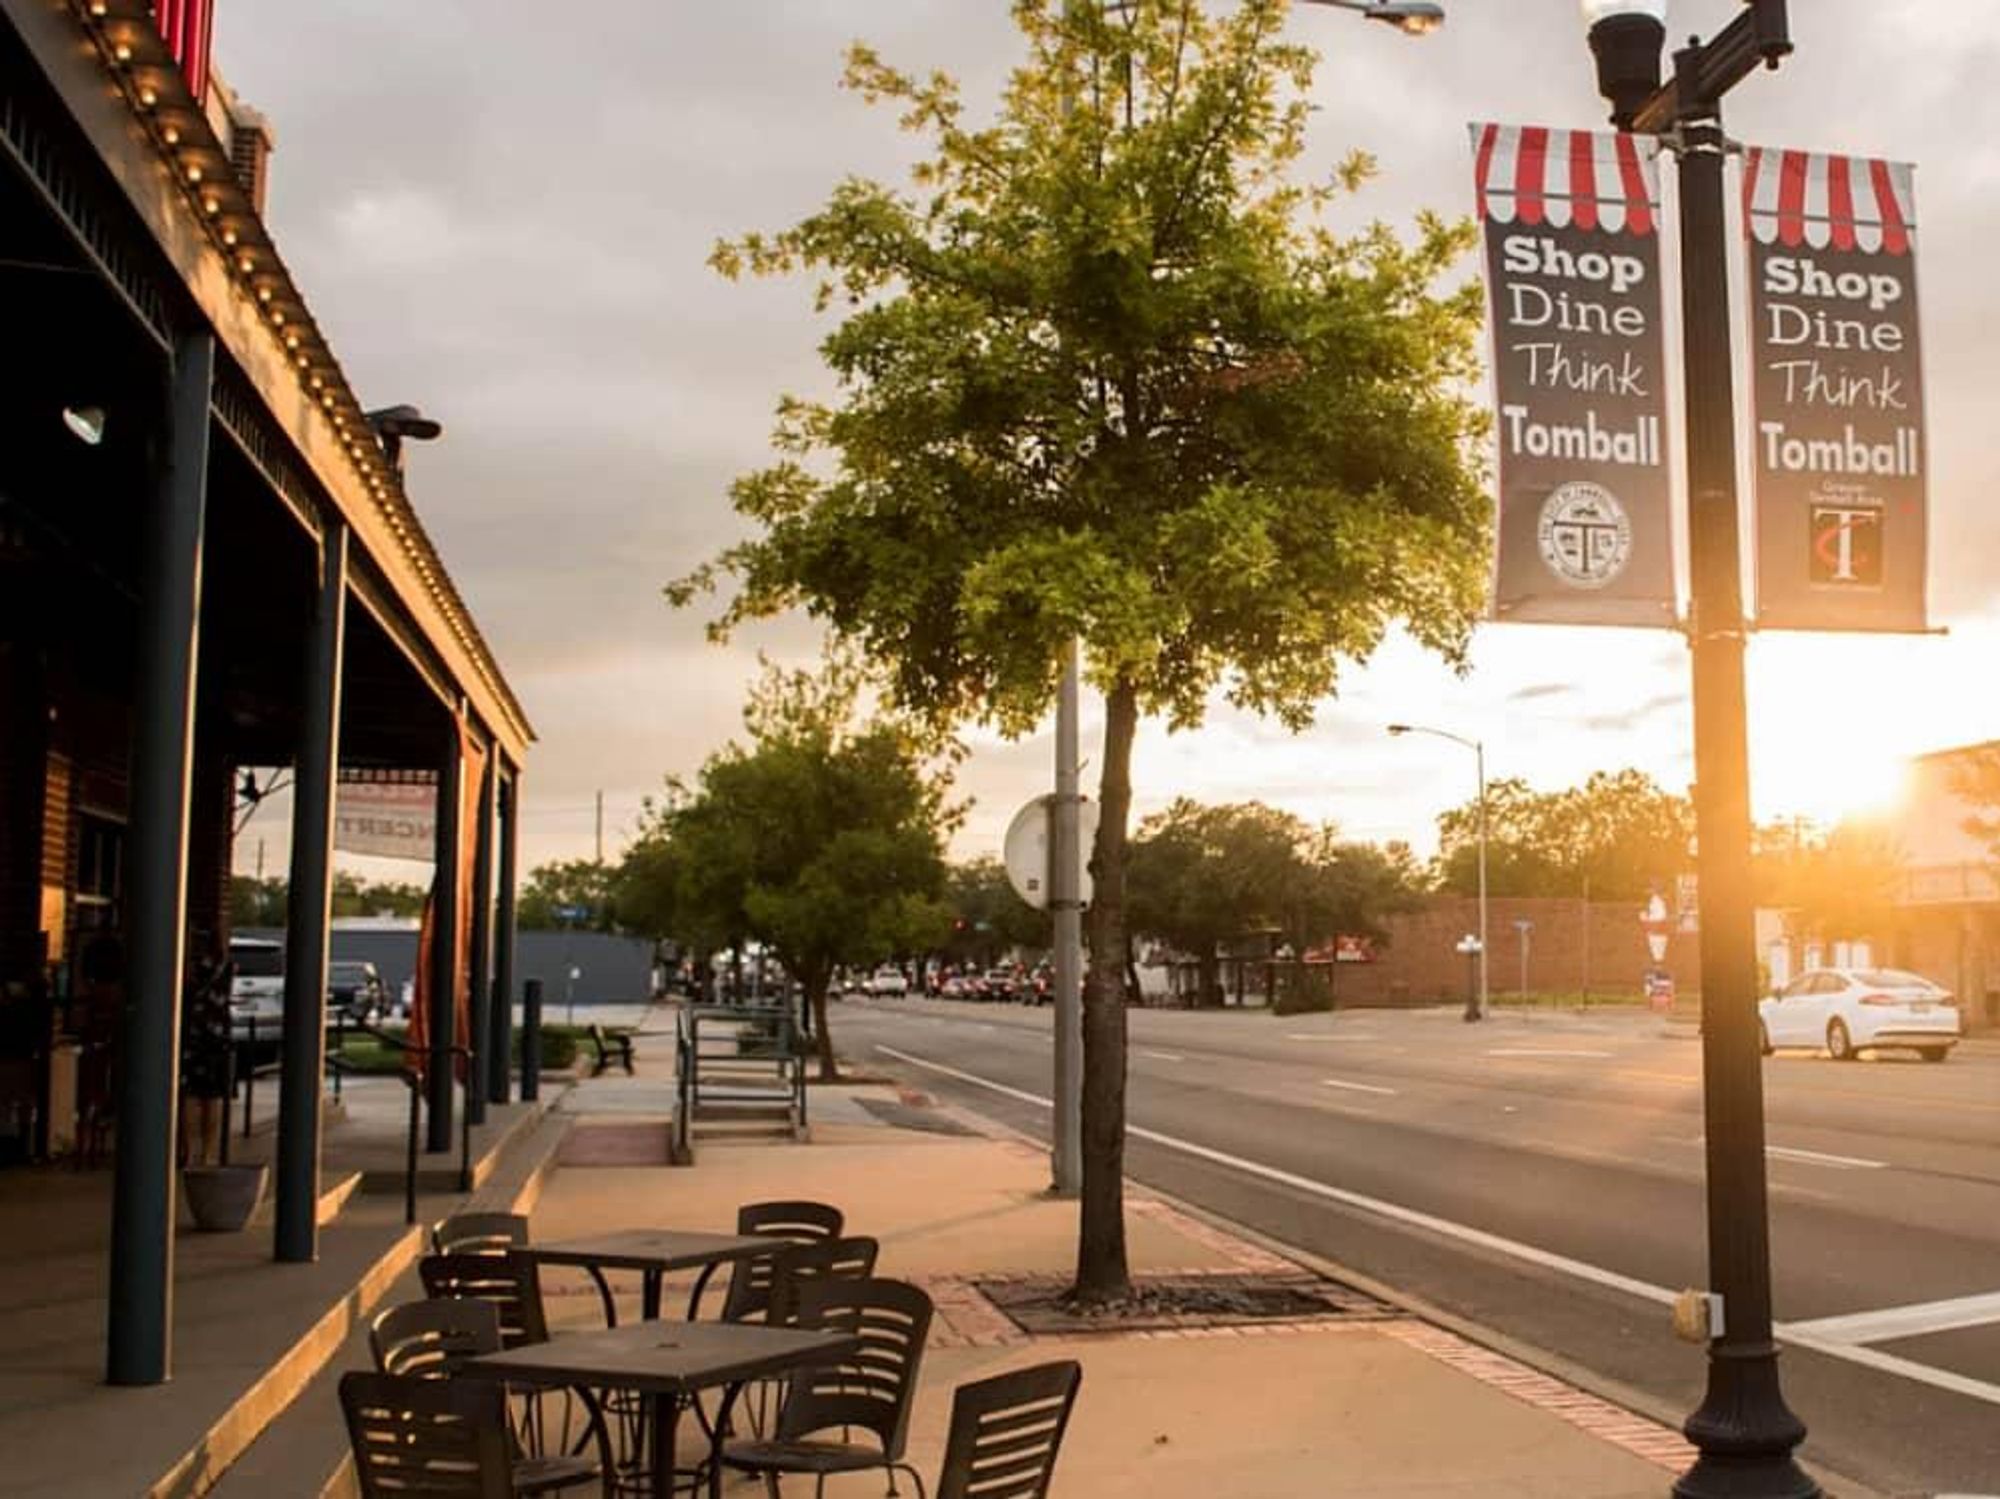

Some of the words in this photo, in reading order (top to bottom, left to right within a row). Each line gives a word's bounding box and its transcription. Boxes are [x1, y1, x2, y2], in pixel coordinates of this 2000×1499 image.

[1504, 235, 1645, 292] Shop
[1764, 256, 1902, 310] Shop
[1506, 283, 1645, 336] Dine
[1766, 303, 1903, 352] Dine
[1512, 342, 1649, 396] Think
[1768, 360, 1907, 410] Think
[1503, 405, 1659, 466] Tomball
[1760, 422, 1917, 475] Tomball
